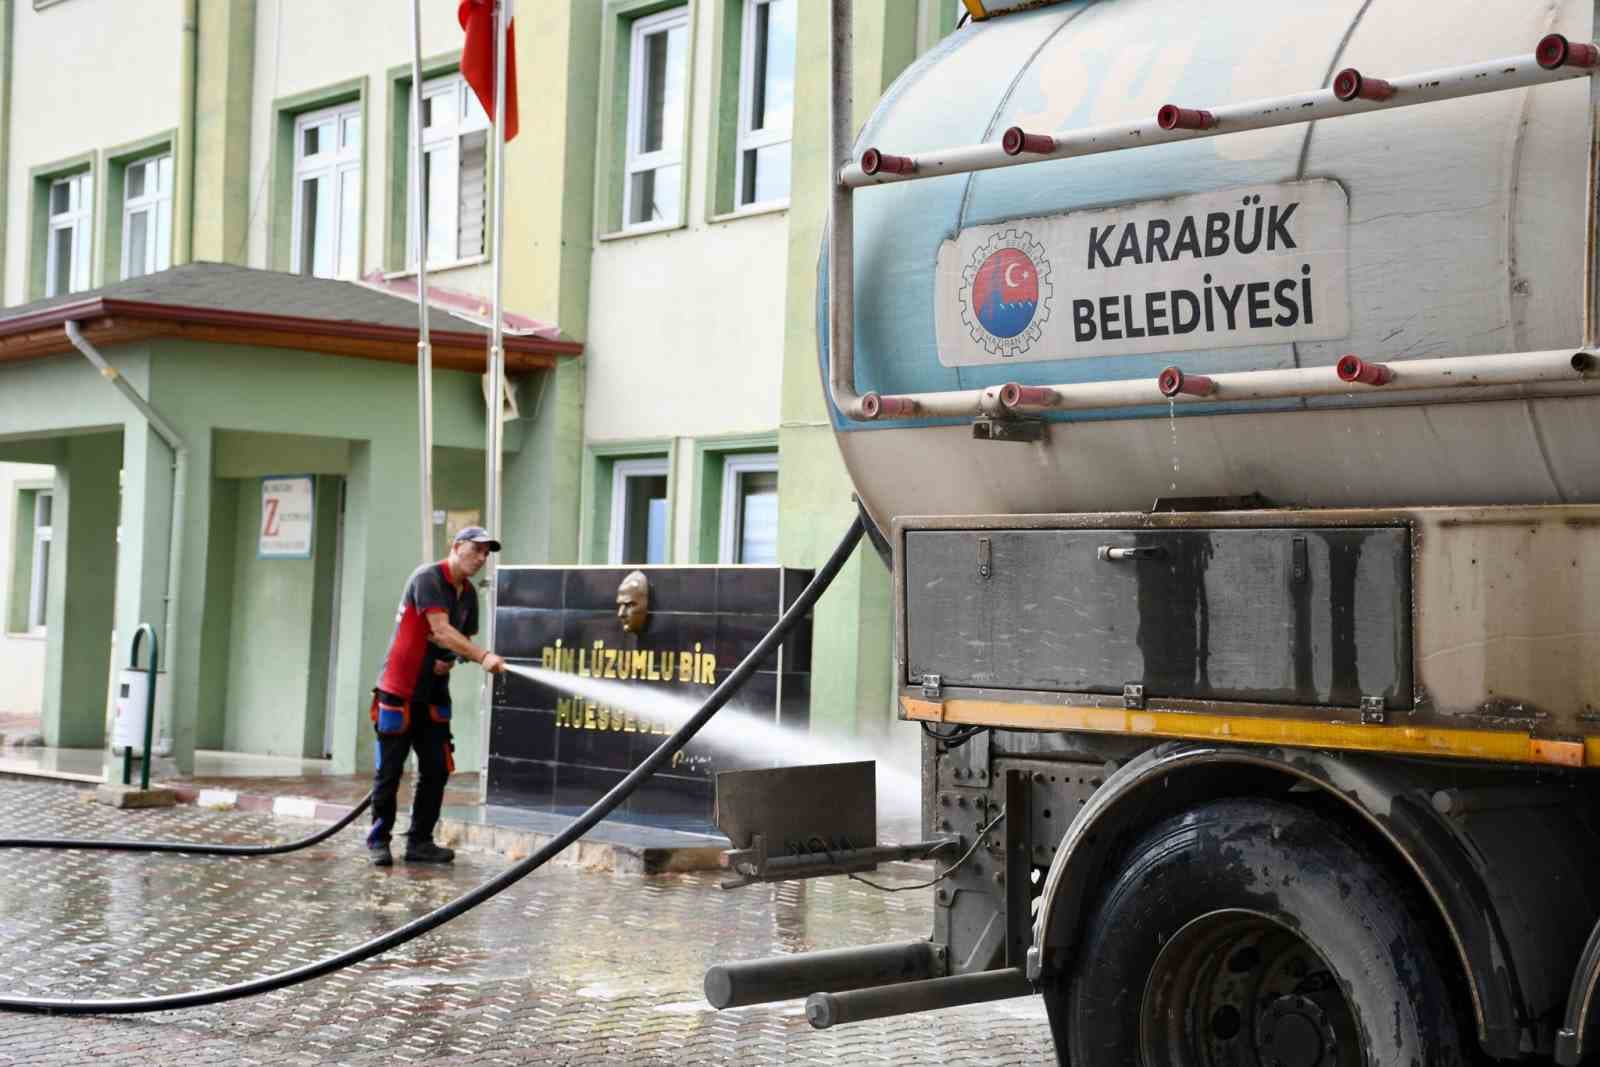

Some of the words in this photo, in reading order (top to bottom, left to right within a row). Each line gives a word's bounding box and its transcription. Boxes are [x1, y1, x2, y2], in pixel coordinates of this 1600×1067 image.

[1088, 194, 1298, 269] KARABÜK
[1073, 264, 1312, 342] BELEDİYESİ
[579, 640, 674, 681] LÜZUMLU
[679, 642, 716, 684] BİR
